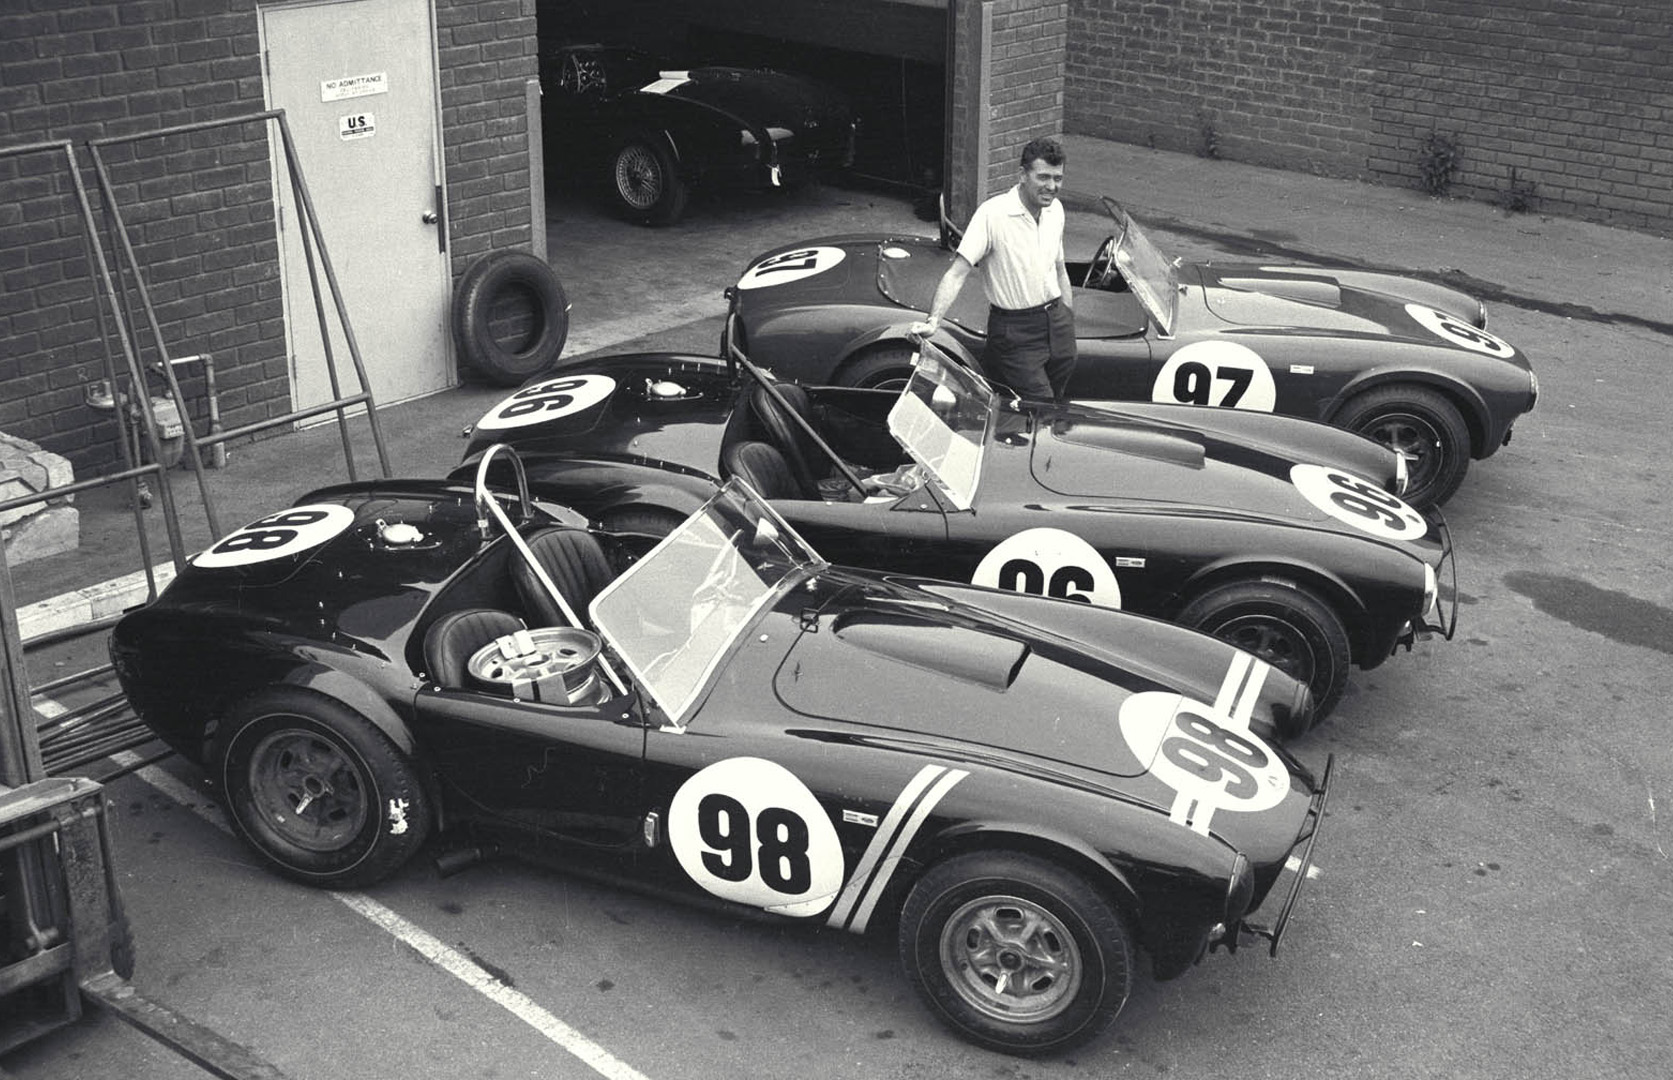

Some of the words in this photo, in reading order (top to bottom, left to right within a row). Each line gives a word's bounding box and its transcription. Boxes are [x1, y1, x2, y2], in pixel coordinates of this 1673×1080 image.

[339, 75, 382, 87] ADMITTANCE
[755, 250, 819, 277] 97
[498, 379, 588, 419] 96
[1173, 361, 1254, 408] 97
[1327, 473, 1407, 531] 96
[212, 511, 329, 554] 98
[1162, 711, 1269, 800] 98
[698, 794, 811, 895] 98
